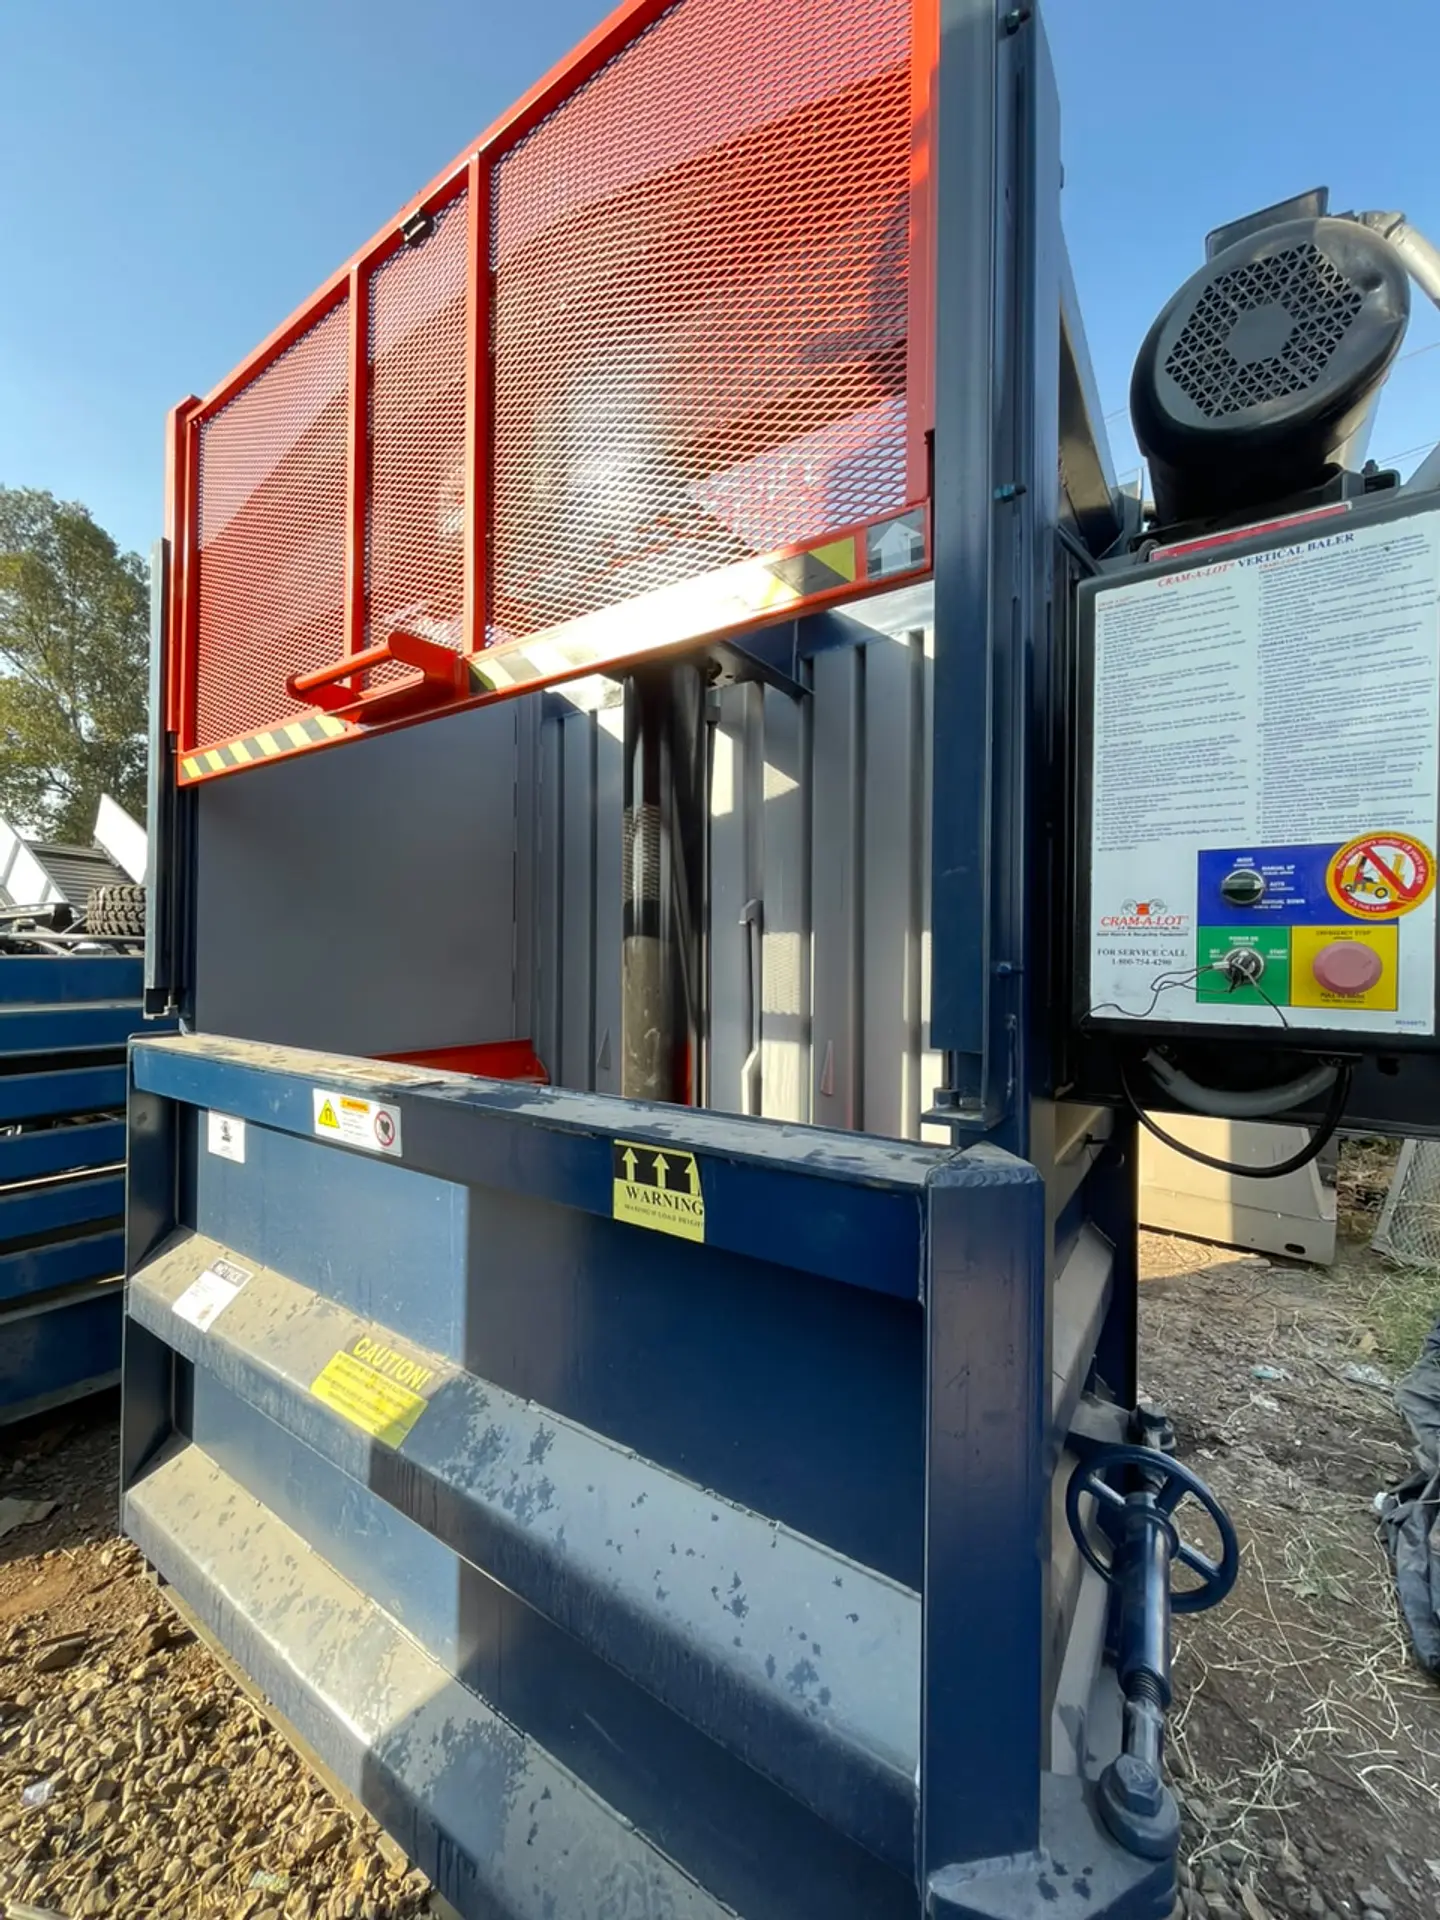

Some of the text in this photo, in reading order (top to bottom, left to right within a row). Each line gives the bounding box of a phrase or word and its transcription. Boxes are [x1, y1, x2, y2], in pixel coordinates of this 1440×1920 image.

[1238, 545, 1305, 568] VERTICAL
[1307, 532, 1355, 552] BALER
[1097, 948, 1188, 957] FOR SERVICE CALL
[625, 1185, 703, 1216] WARNING
[353, 1336, 436, 1392] CAUTION!
